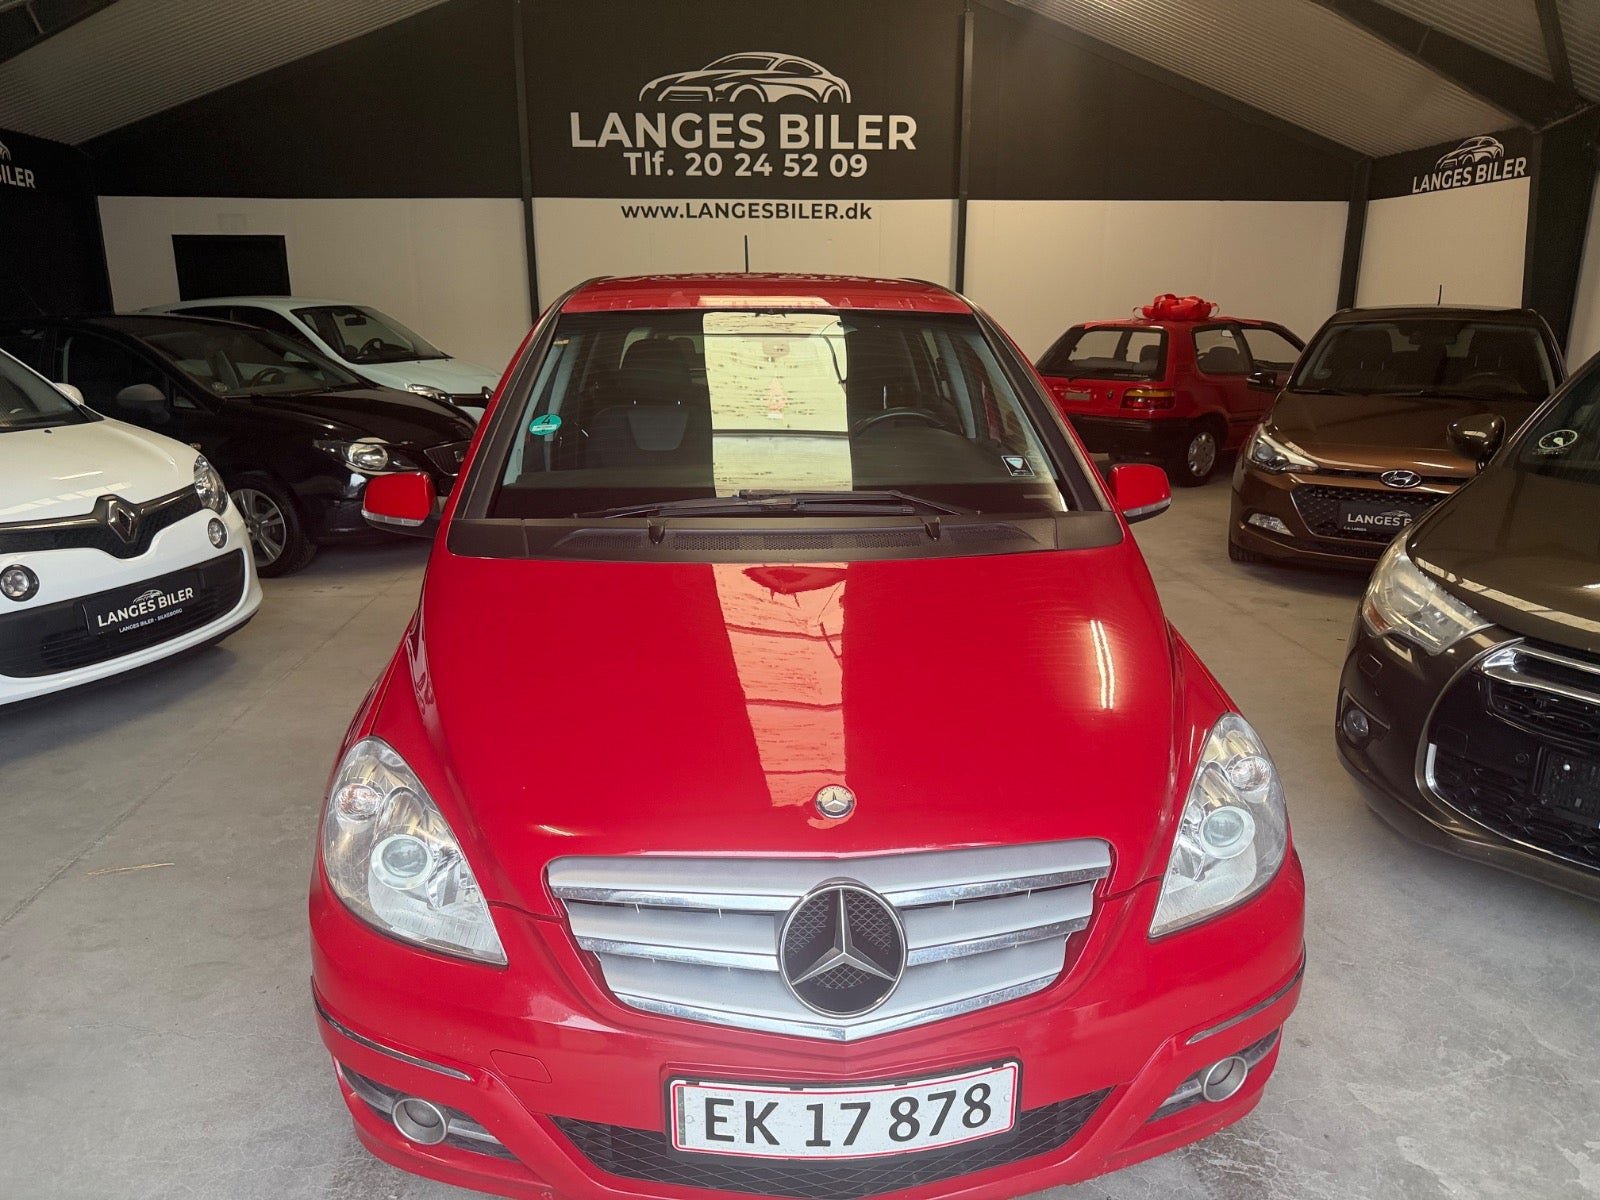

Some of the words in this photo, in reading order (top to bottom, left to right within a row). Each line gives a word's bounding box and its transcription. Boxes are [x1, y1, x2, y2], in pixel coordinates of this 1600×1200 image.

[570, 112, 766, 149] LANGES
[779, 114, 917, 150] BILER
[0, 164, 36, 189] ILER
[623, 151, 675, 177] Tlf.
[685, 152, 723, 177] 20
[734, 153, 773, 177] 24
[783, 153, 819, 178] 52
[829, 153, 868, 178] 09
[1412, 166, 1472, 193] LANGES
[1476, 157, 1526, 183] BILER
[621, 202, 872, 221] www.LANGESBILER.dk
[542, 415, 551, 424] 4
[1347, 513, 1401, 527] LANGES
[97, 599, 156, 627] LANGES
[157, 587, 194, 609] BILER
[119, 622, 140, 633] LANGES
[705, 1097, 780, 1146] EK
[805, 1101, 871, 1147] 17
[888, 1082, 992, 1143] 878
